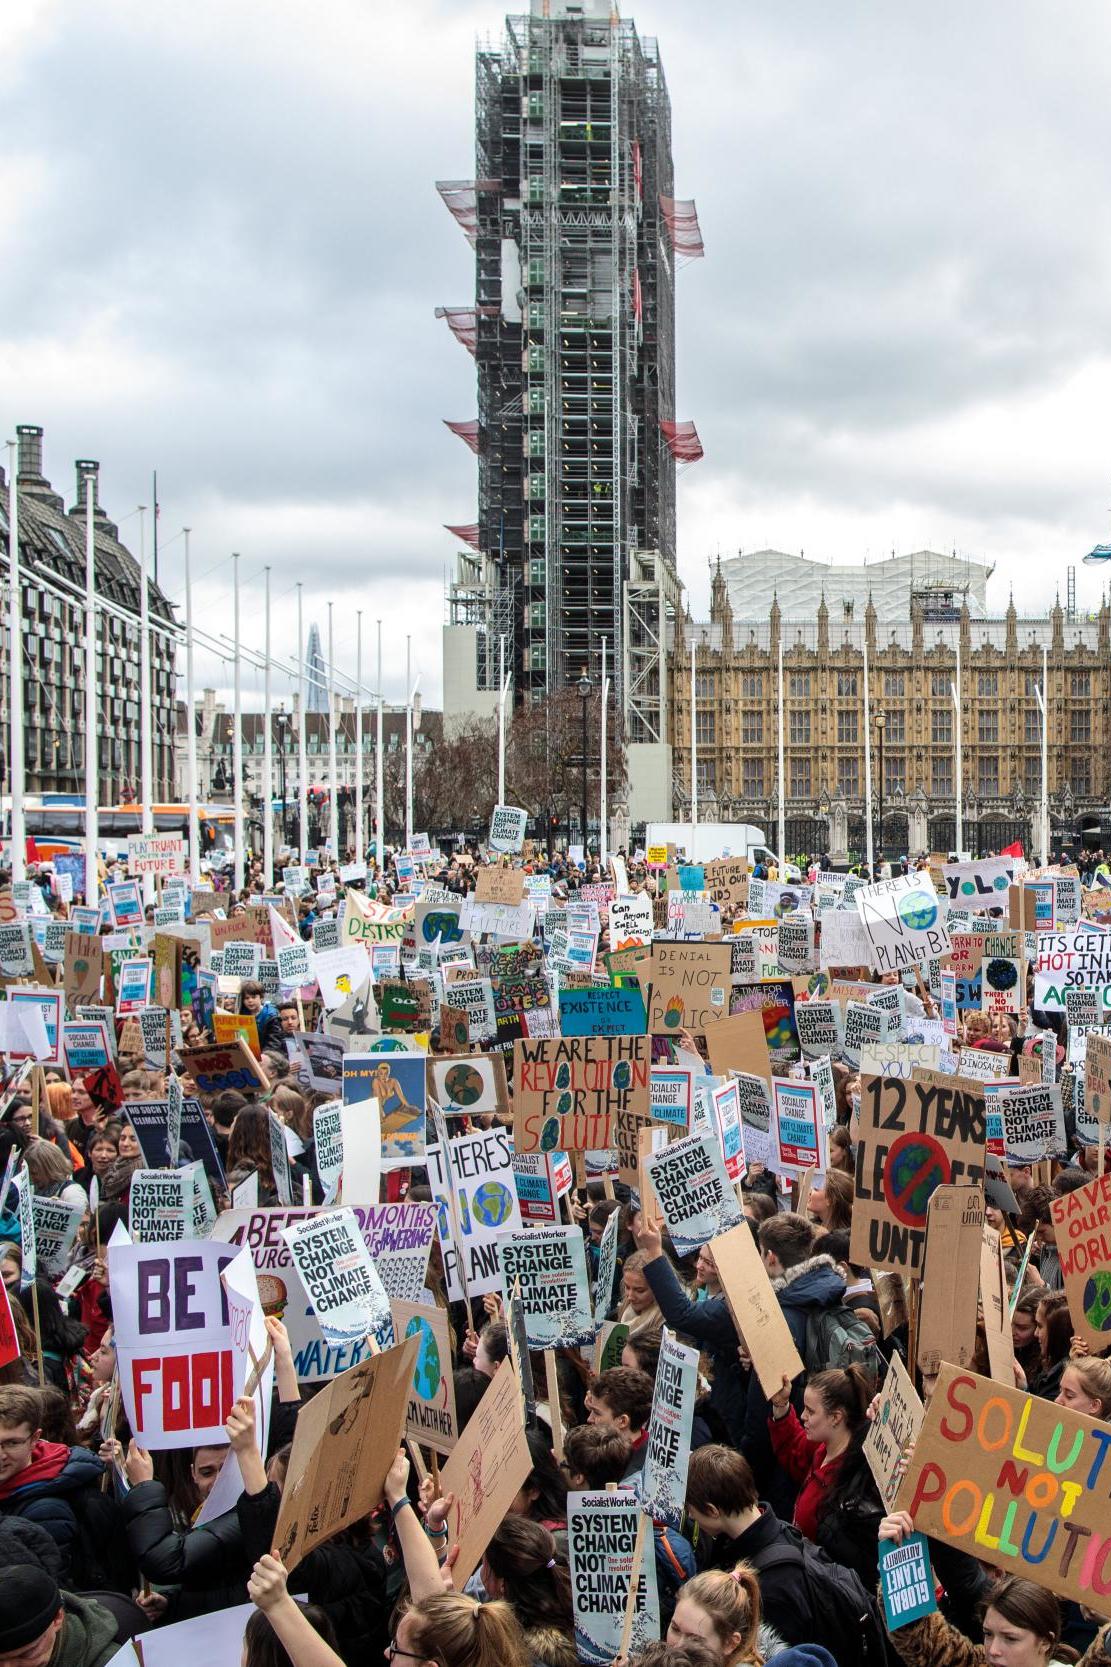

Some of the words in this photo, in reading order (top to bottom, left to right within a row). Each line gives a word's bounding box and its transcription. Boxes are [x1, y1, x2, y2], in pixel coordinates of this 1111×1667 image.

[151, 840, 182, 852] TRUANT
[135, 859, 175, 872] FUTURE
[712, 866, 741, 877] FUTURE
[708, 877, 727, 888] IN
[729, 874, 747, 886] OUR
[861, 882, 901, 899] THERE
[905, 875, 921, 886] IS
[612, 904, 630, 914] Can
[927, 926, 949, 954] B!
[985, 936, 1017, 957] CHANGE
[1039, 936, 1068, 952] ITS
[659, 950, 712, 961] DENIAL
[1039, 953, 1075, 971] HOT
[1078, 953, 1102, 970] IN
[659, 966, 675, 976] IS
[681, 970, 723, 986] NOT
[1065, 971, 1084, 986] SO
[587, 991, 620, 999] RESPECT
[653, 989, 662, 999] A
[561, 1000, 632, 1015] EXISTENCE
[592, 1024, 625, 1032] EXPECT
[521, 1039, 552, 1063] WE
[554, 1038, 597, 1062] ARE
[602, 1036, 646, 1061] THE
[140, 1106, 160, 1114] SUCH
[542, 1090, 596, 1116] FOR
[600, 1088, 632, 1117] THE
[867, 1076, 907, 1132] 12
[914, 1083, 986, 1144] YEARS
[133, 1116, 166, 1125] CLIMATE
[132, 1183, 182, 1196] SYSTEM
[132, 1195, 184, 1208] CHANGE
[132, 1207, 156, 1219] NOT
[364, 1204, 439, 1231] MONTHS
[131, 1219, 185, 1232] CLIMATE
[1068, 1206, 1111, 1239] OUR
[292, 1225, 349, 1257] SYSTEM
[298, 1239, 357, 1271] CHANGE
[502, 1243, 568, 1260] SYSTEM
[303, 1262, 335, 1285] NOT
[503, 1257, 573, 1273] CHANGE
[310, 1266, 370, 1299] CLIMATE
[507, 1272, 539, 1287] NOT
[137, 1255, 206, 1335] BE
[316, 1281, 373, 1313] CHANGE
[507, 1284, 578, 1301] CLIMATE
[996, 1459, 1084, 1517] NOT
[885, 1543, 921, 1568] AUTHORITY
[886, 1559, 926, 1594] PLANET
[891, 1580, 929, 1616] GLOBAL
